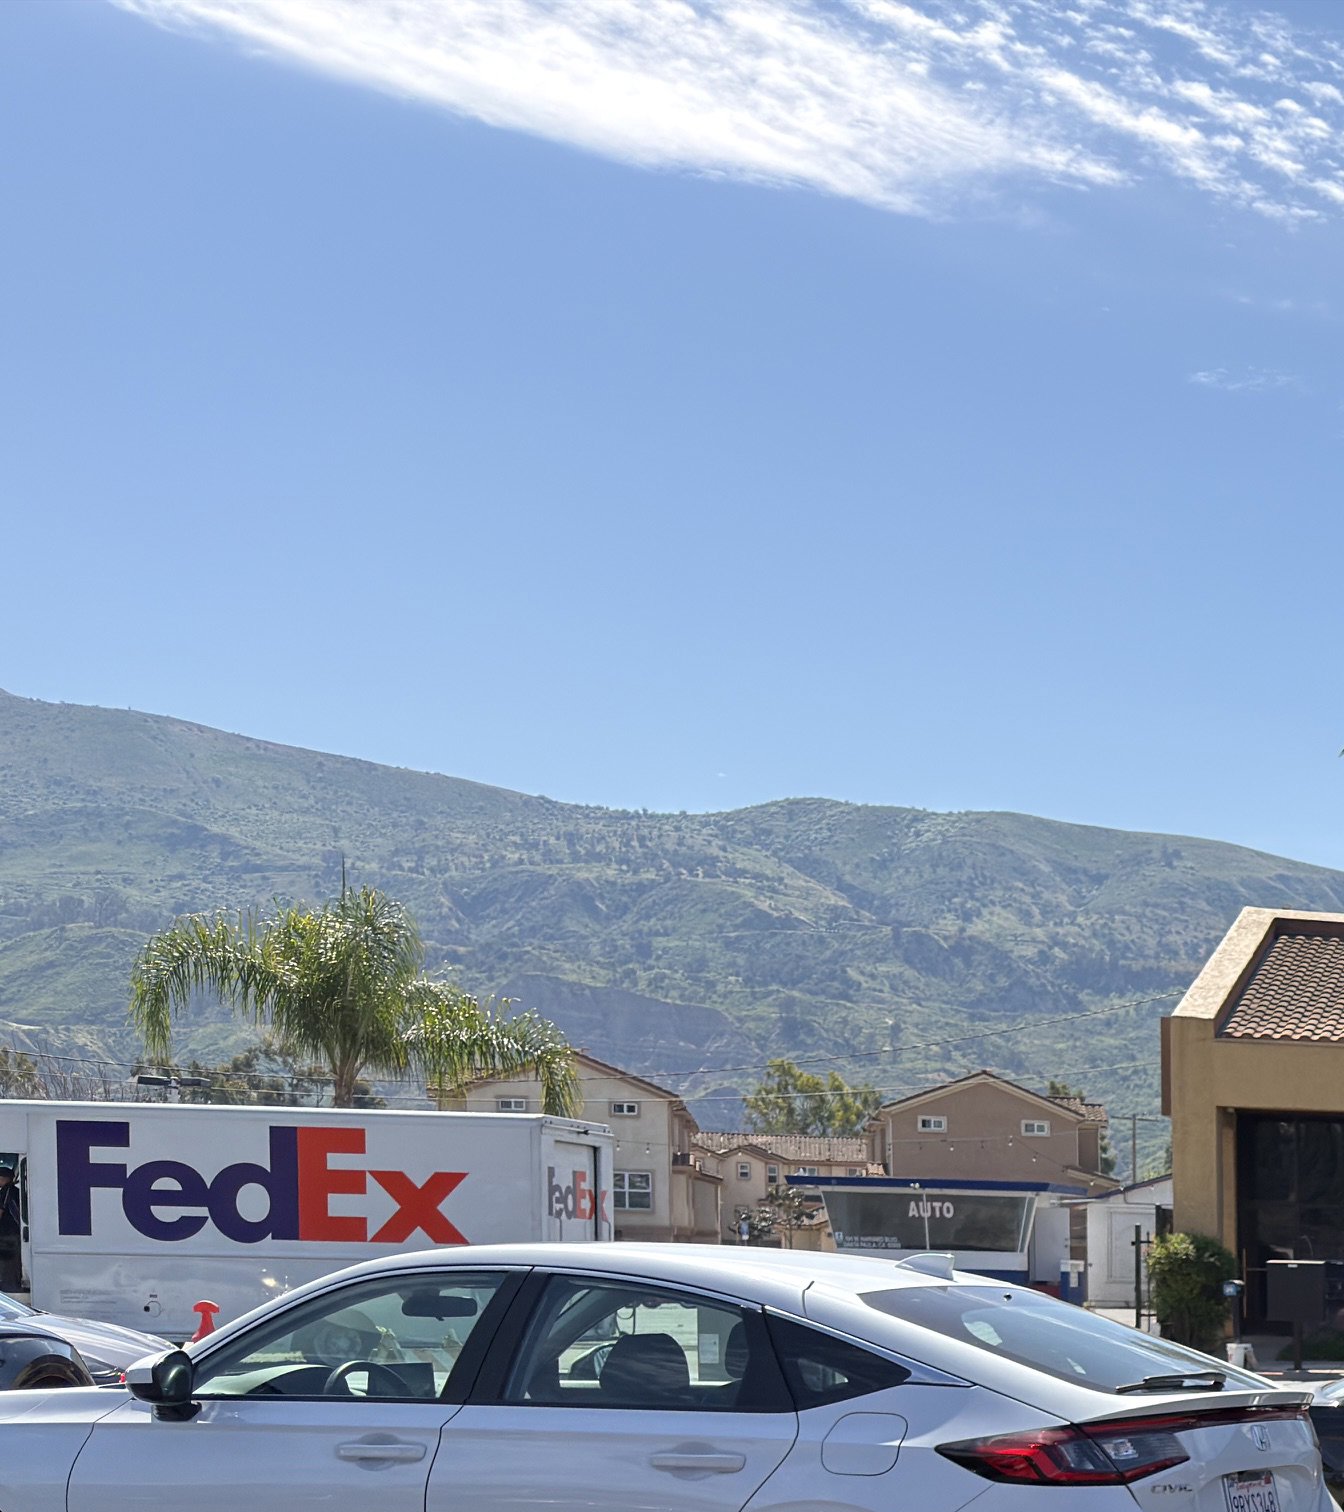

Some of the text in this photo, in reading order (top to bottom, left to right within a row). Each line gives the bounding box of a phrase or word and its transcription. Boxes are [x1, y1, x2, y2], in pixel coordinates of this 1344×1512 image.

[56, 1119, 471, 1245] FedEx
[908, 1200, 955, 1219] AUTO
[1150, 1483, 1193, 1494] CIVIC
